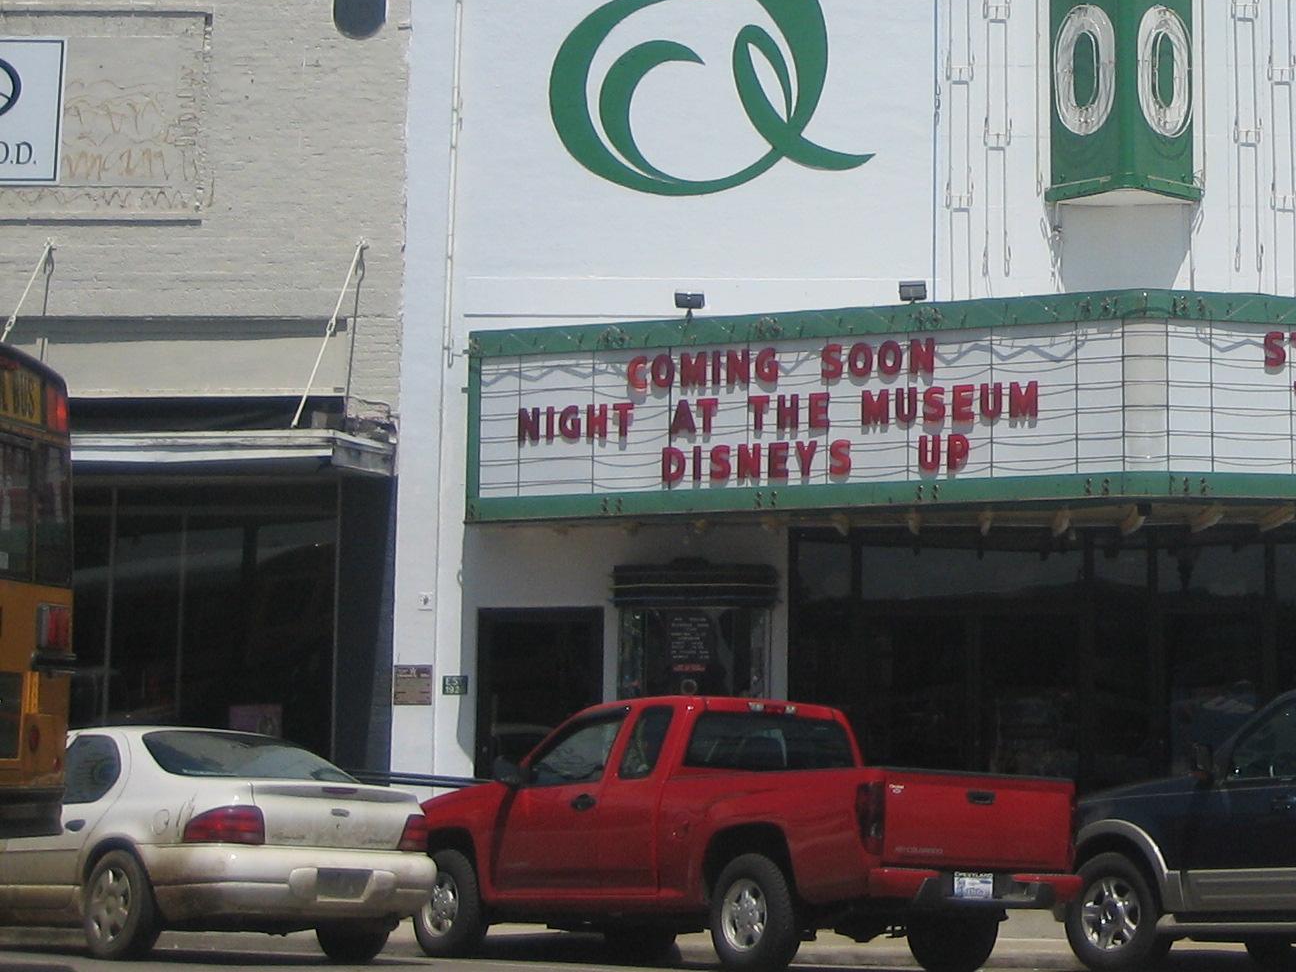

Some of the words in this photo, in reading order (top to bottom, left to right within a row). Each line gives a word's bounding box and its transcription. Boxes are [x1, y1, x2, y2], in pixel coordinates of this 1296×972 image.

[628, 346, 778, 390] COMING
[821, 337, 935, 380] SOON
[518, 402, 634, 446] NIGHT
[669, 397, 718, 435] AT
[747, 391, 831, 432] THE
[861, 380, 1039, 426] MUSEUM
[662, 439, 852, 483] DISNEYS
[918, 433, 970, 472] UP
